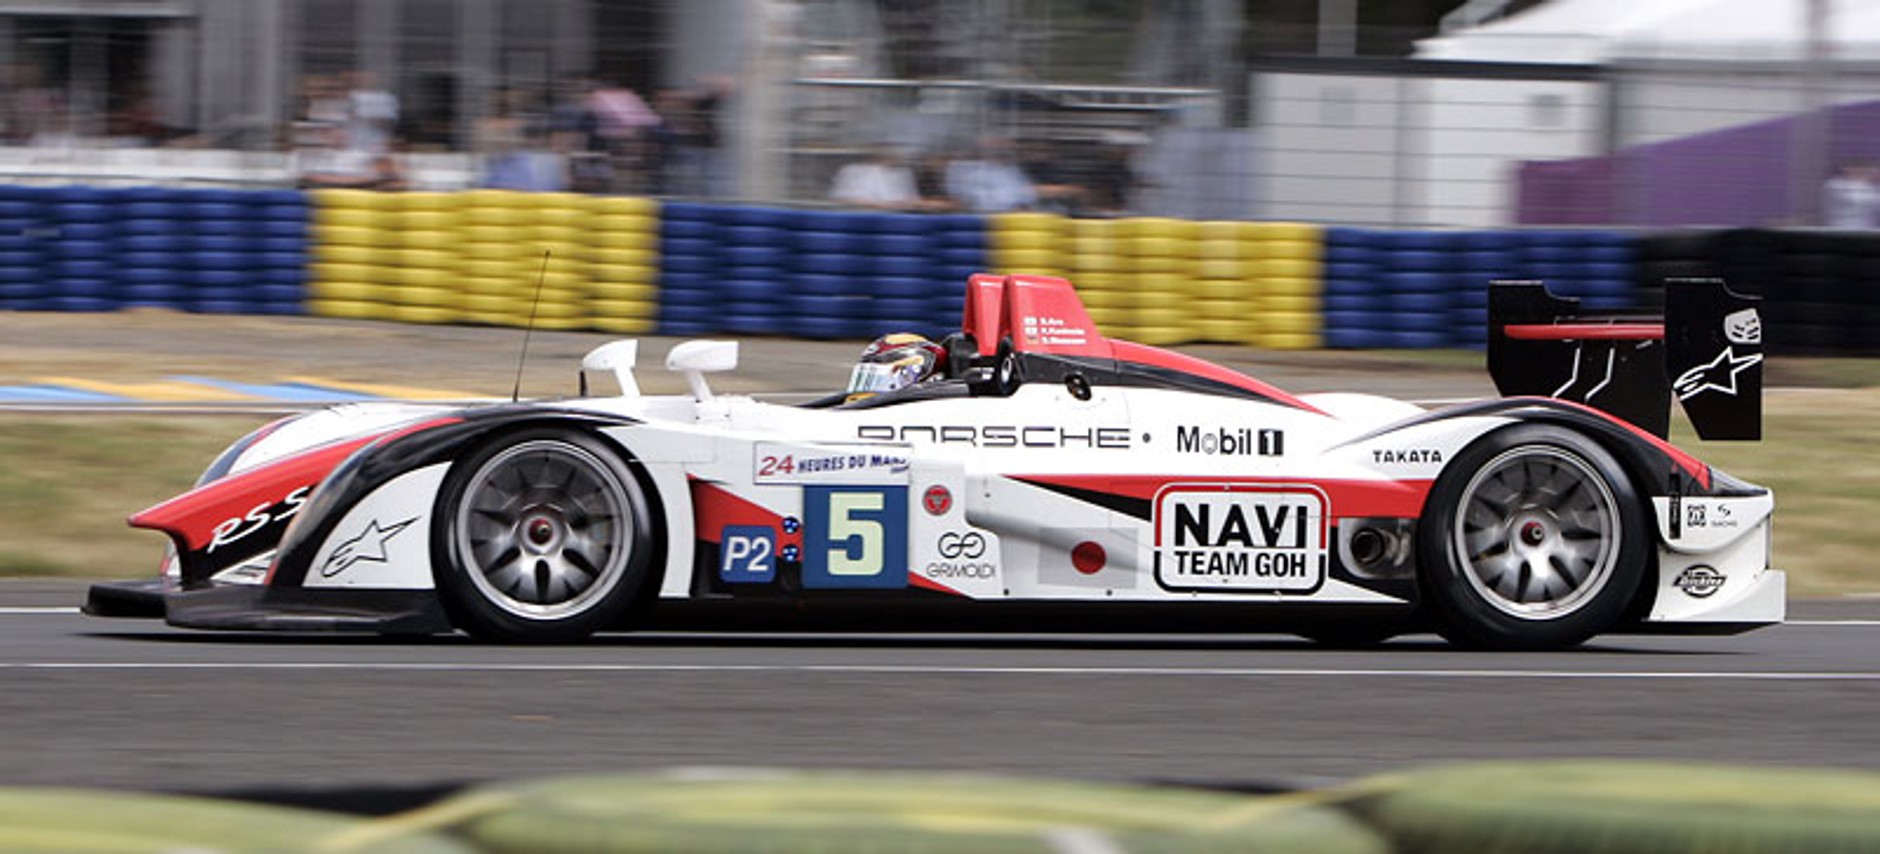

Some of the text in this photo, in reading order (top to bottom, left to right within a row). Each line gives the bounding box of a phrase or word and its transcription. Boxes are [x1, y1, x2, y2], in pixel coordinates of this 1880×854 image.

[857, 426, 1131, 449] PORSCHE
[1176, 425, 1252, 455] Mobil
[758, 455, 795, 476] 24
[797, 456, 845, 473] HEURES
[848, 455, 867, 469] DU
[1373, 449, 1442, 463] TAKATA
[826, 491, 885, 576] 5
[1174, 502, 1308, 549] NAVI
[723, 535, 773, 571] P2
[1175, 550, 1306, 578] TEAM GOH
[926, 562, 996, 579] GRIMOLDI
